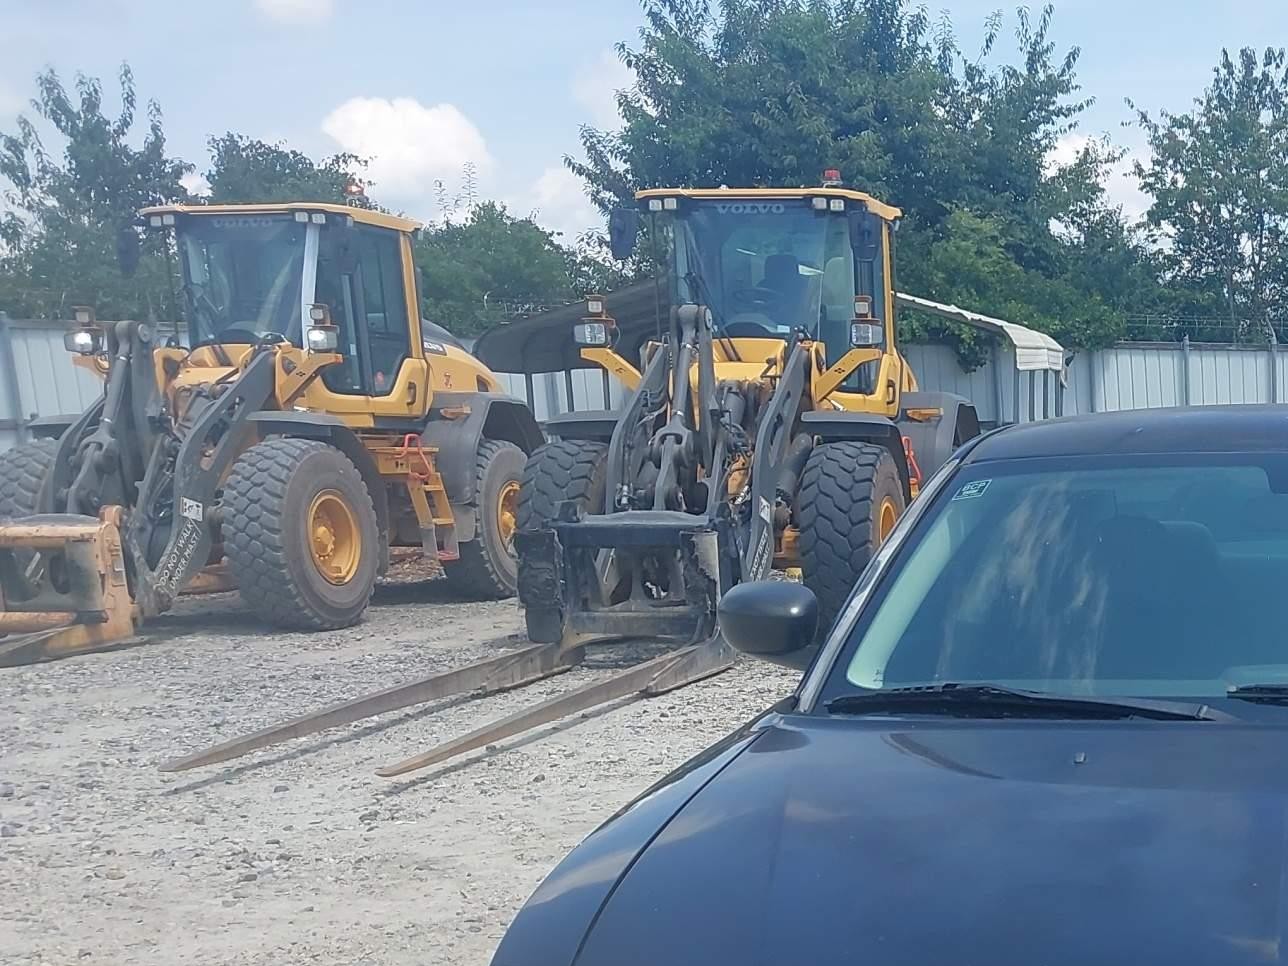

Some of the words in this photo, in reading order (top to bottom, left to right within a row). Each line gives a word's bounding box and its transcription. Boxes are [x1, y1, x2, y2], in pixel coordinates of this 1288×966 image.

[715, 203, 785, 214] VOLVO
[159, 569, 170, 586] DO
[167, 547, 181, 570] NOT
[177, 521, 195, 548] WALK
[169, 557, 189, 589] UNDER
[185, 533, 199, 559] MAST
